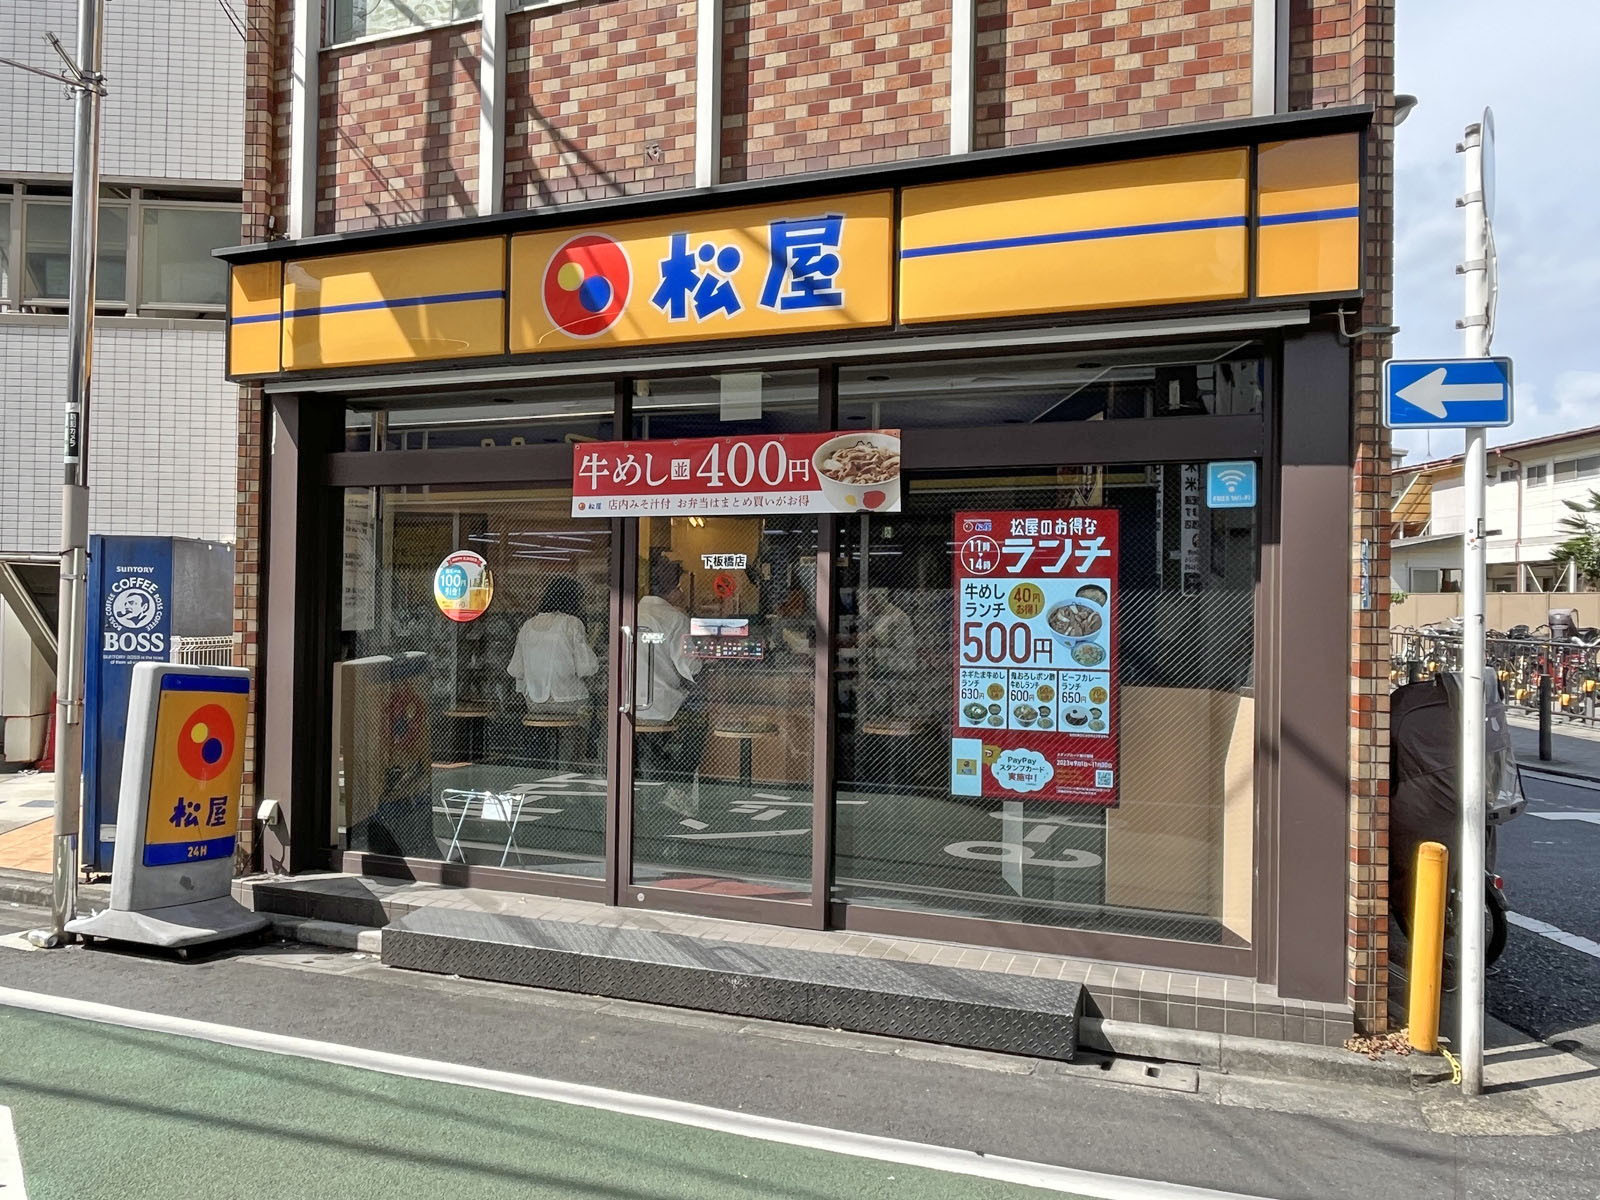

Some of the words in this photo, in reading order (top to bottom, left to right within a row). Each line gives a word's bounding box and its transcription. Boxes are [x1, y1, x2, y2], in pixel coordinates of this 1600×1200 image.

[651, 213, 845, 322] 松屋
[608, 498, 670, 511] 店内みそ汁付
[677, 494, 810, 510] お弁当はまとめ買いがお得
[1010, 517, 1097, 536] 松屋のお得な
[702, 554, 747, 569] 下板橋店
[1002, 536, 1111, 573] ランチ
[112, 577, 158, 594] COFFEE
[965, 583, 1005, 600] 牛めし
[1013, 588, 1041, 602] 40円
[965, 602, 1006, 618] ランチ
[103, 632, 164, 652] BOSS
[963, 621, 1053, 664] 500円
[961, 670, 1006, 680] ネギたま牛めし
[1061, 673, 1102, 683] ビーフカレー
[961, 679, 980, 688] ランチ
[1062, 682, 1081, 691] ランチ
[961, 687, 985, 700] 630円
[1010, 689, 1035, 702] 600円
[1061, 691, 1087, 704] 650円
[1007, 756, 1037, 765] PayPay
[999, 764, 1046, 773] スタンプカード
[169, 795, 229, 828] 松屋
[187, 845, 208, 858] 24H
